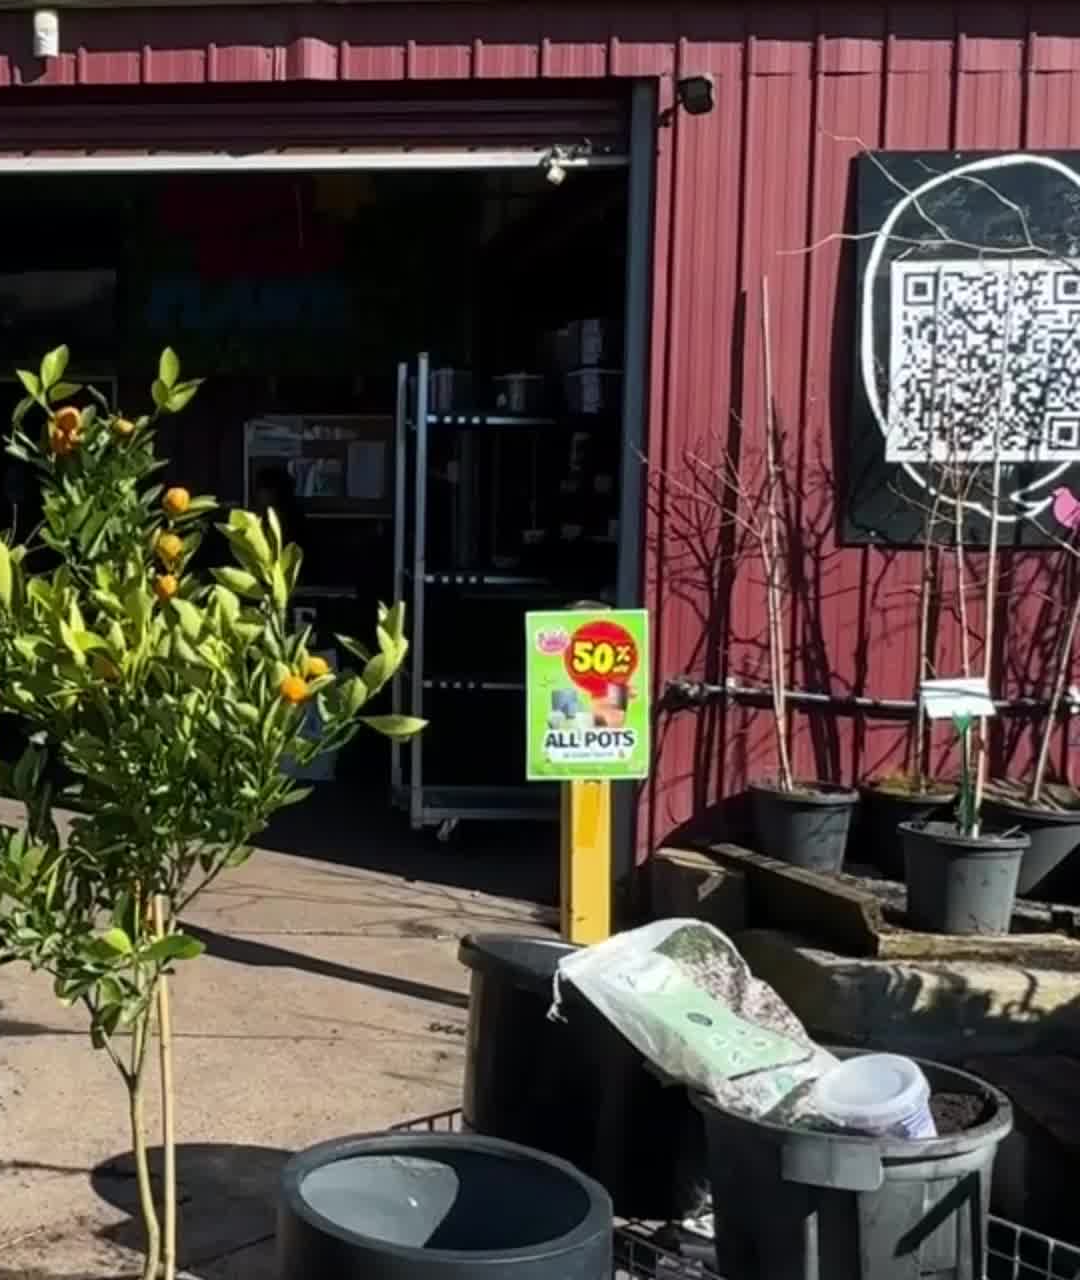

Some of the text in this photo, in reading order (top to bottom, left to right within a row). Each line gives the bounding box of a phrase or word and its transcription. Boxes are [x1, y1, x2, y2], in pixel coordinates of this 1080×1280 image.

[572, 641, 631, 673] 50%
[545, 730, 635, 749] ALL POTS
